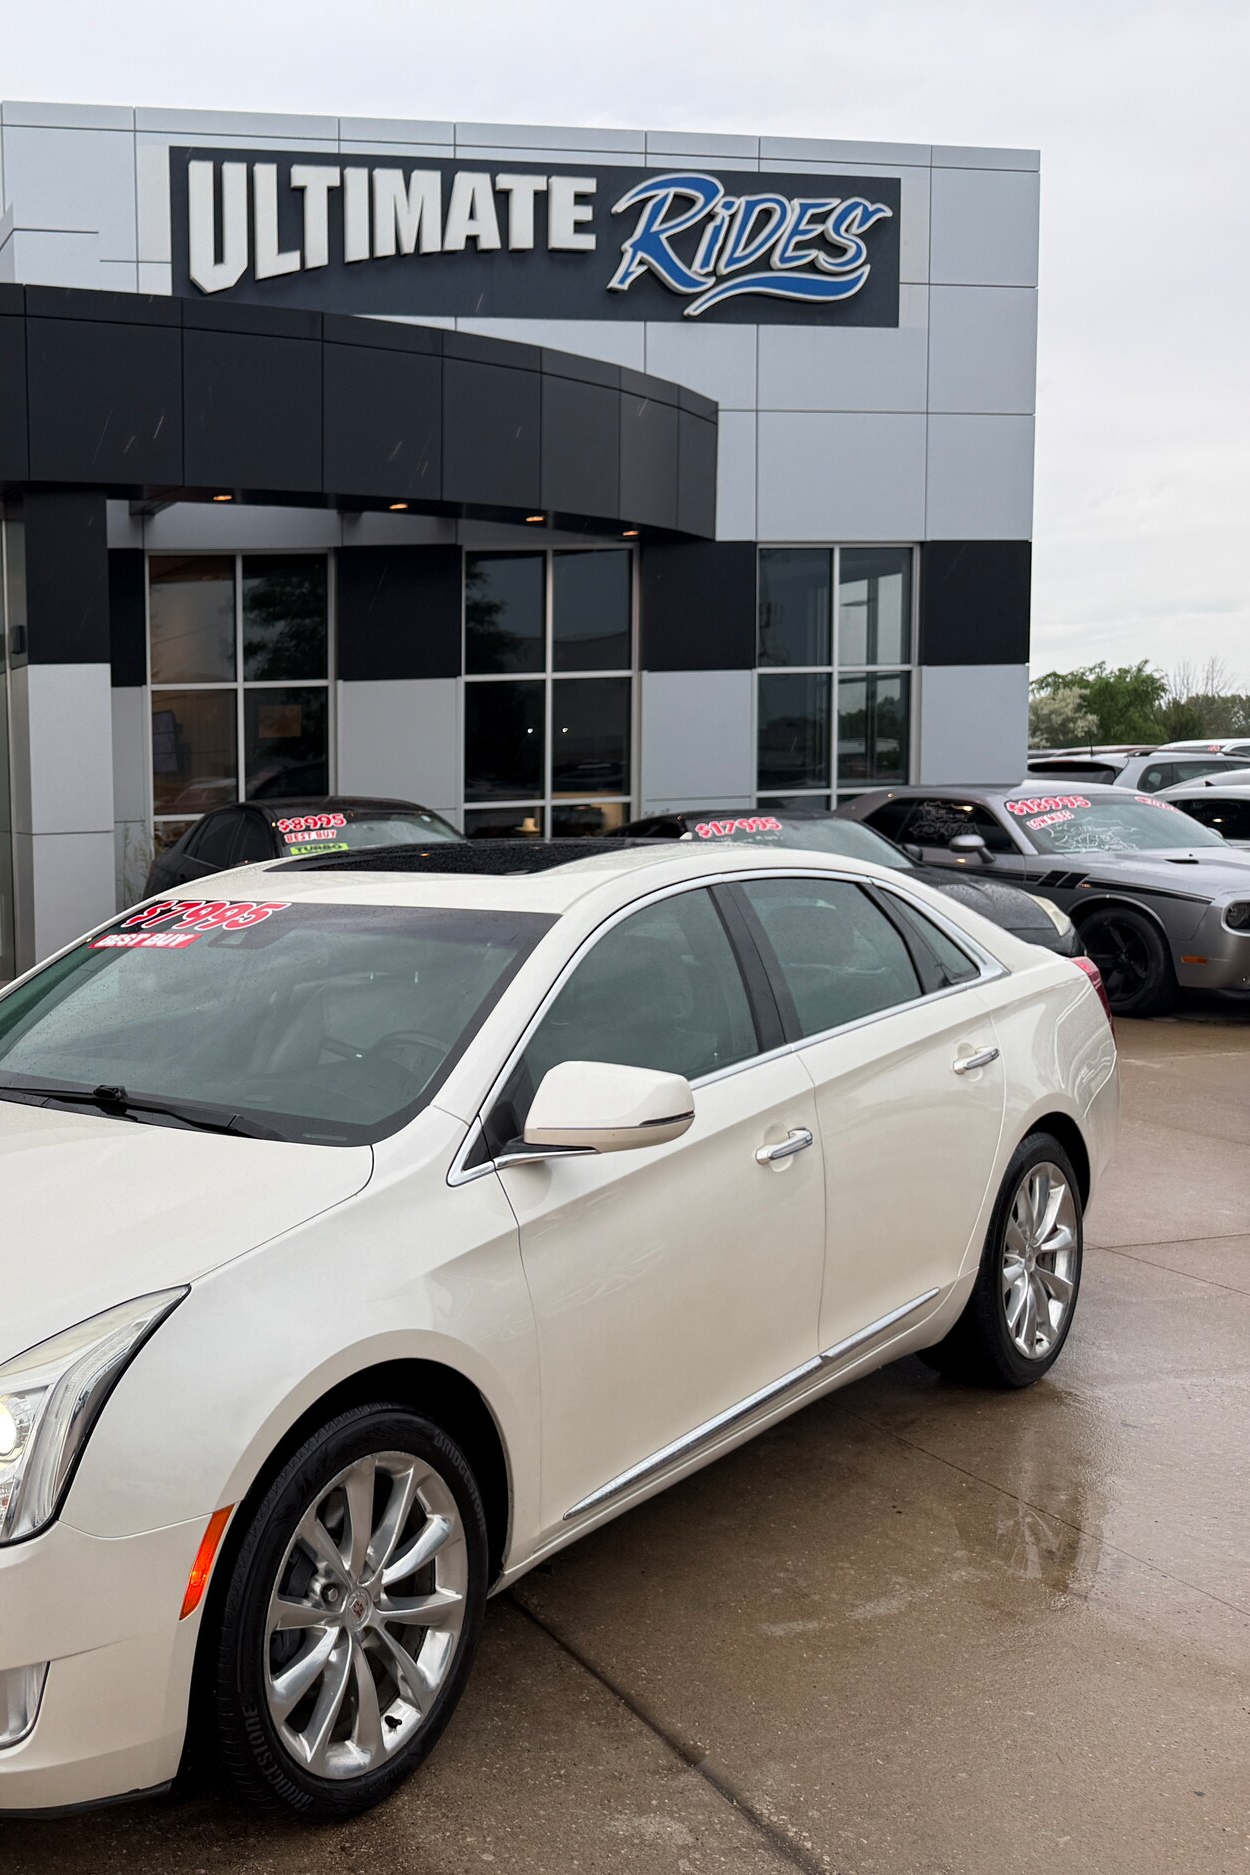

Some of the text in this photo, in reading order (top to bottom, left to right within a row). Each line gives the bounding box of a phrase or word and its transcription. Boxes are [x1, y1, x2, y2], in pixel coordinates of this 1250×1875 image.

[187, 160, 598, 294] ULTIMATE
[277, 813, 347, 833] $8995
[284, 829, 337, 843] BEST BUY
[121, 900, 292, 931] $7995
[96, 934, 190, 948] BEST BUY
[241, 1704, 315, 1812] BRIDGESTONE
